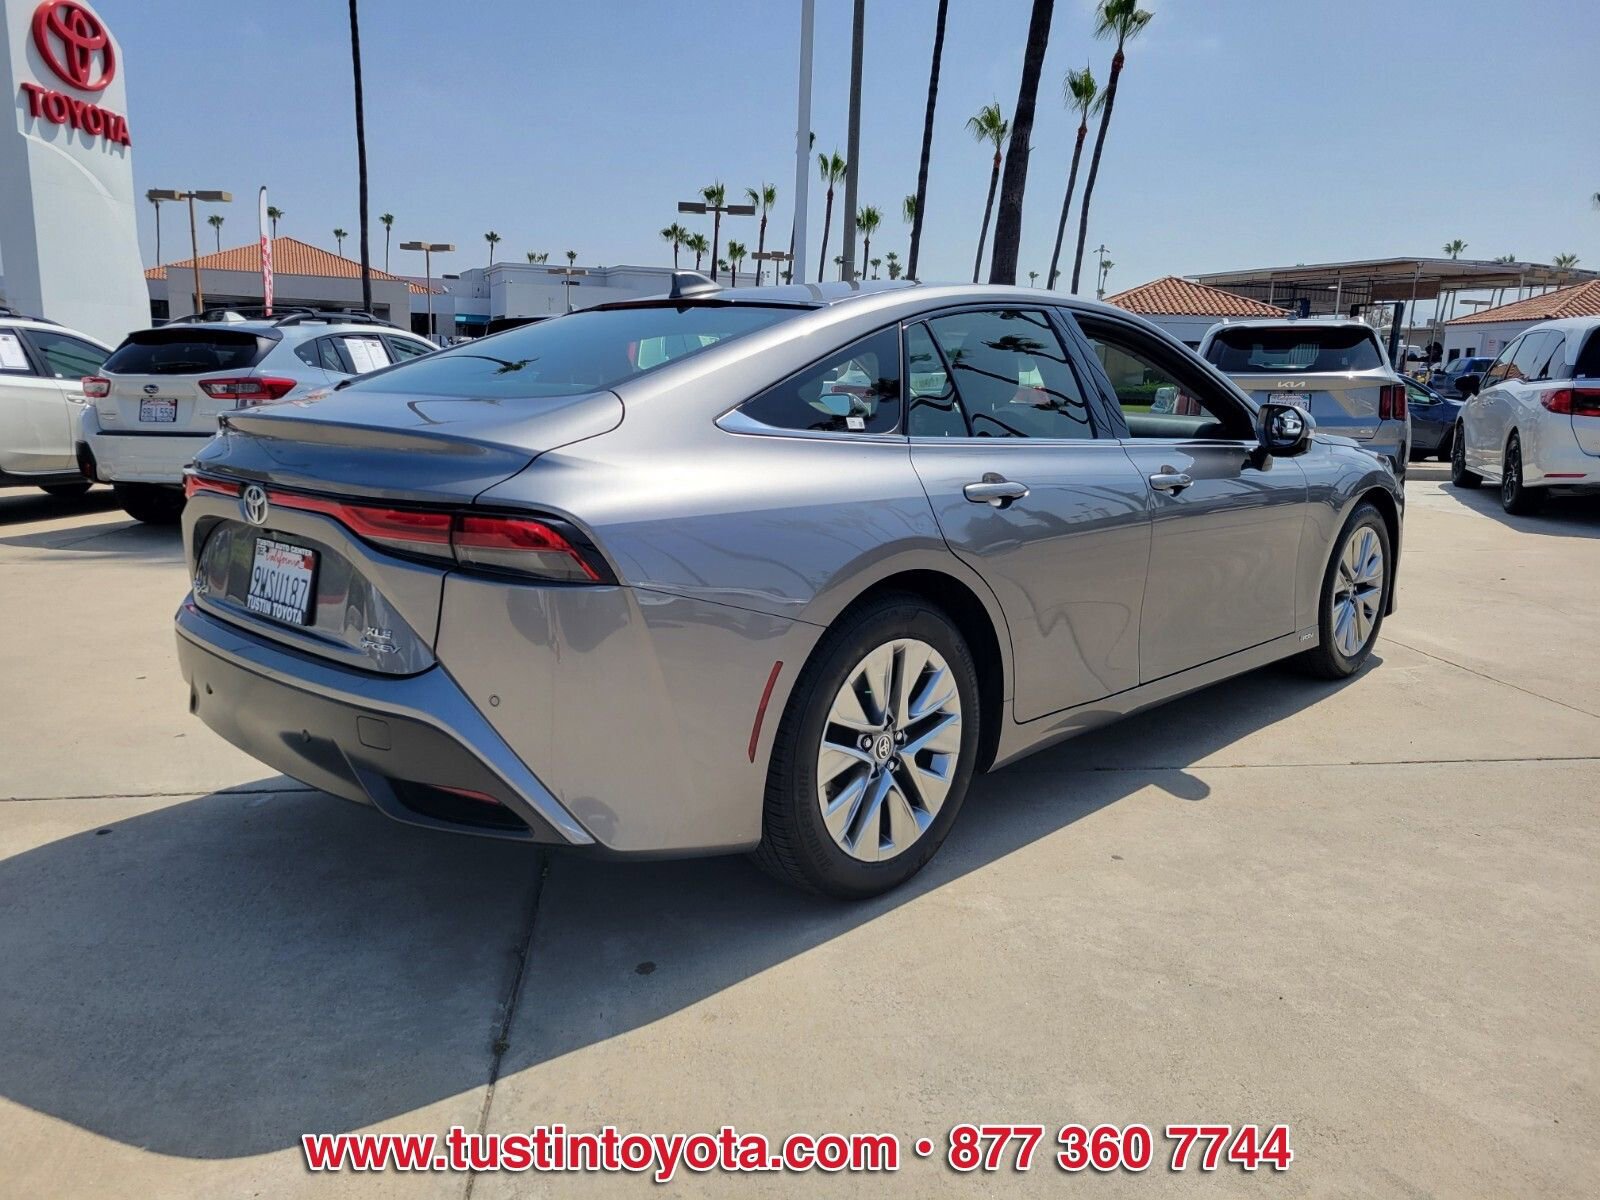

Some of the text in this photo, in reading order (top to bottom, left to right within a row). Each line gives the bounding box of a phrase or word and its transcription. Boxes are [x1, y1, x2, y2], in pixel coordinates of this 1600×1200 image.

[20, 82, 131, 147] TOYOTA
[247, 595, 303, 625] TUSTIN TOYOTA
[366, 627, 392, 640] XLE
